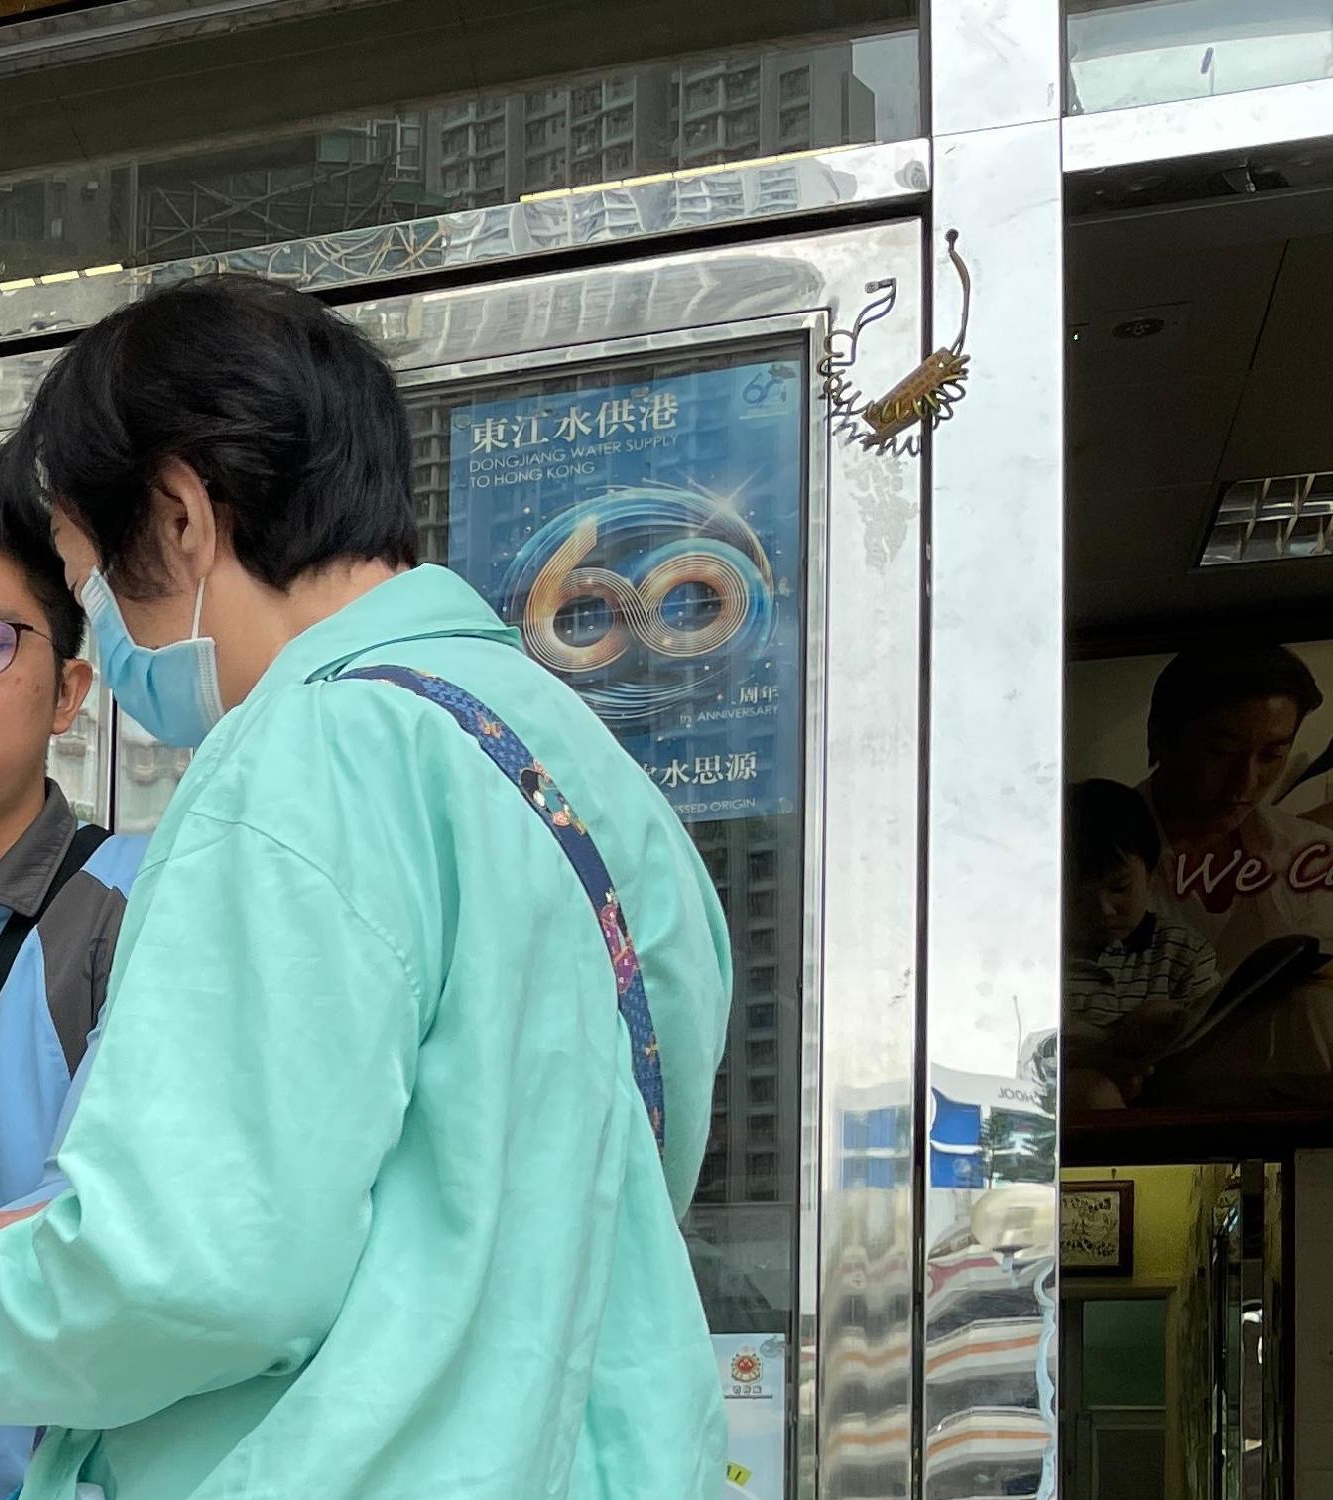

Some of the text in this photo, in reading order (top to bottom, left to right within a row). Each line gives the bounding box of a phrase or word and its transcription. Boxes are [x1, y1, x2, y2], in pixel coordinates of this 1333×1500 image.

[470, 392, 678, 454] 東江水供港
[470, 434, 678, 473] DONGJIANG WATER SUPPLY
[470, 461, 595, 488] TO HONG KONG
[523, 514, 750, 673] 60
[740, 686, 779, 705] 周年
[697, 704, 779, 722] ANNIVERSARY
[709, 798, 757, 811] ORIGIN
[1176, 849, 1273, 895] We
